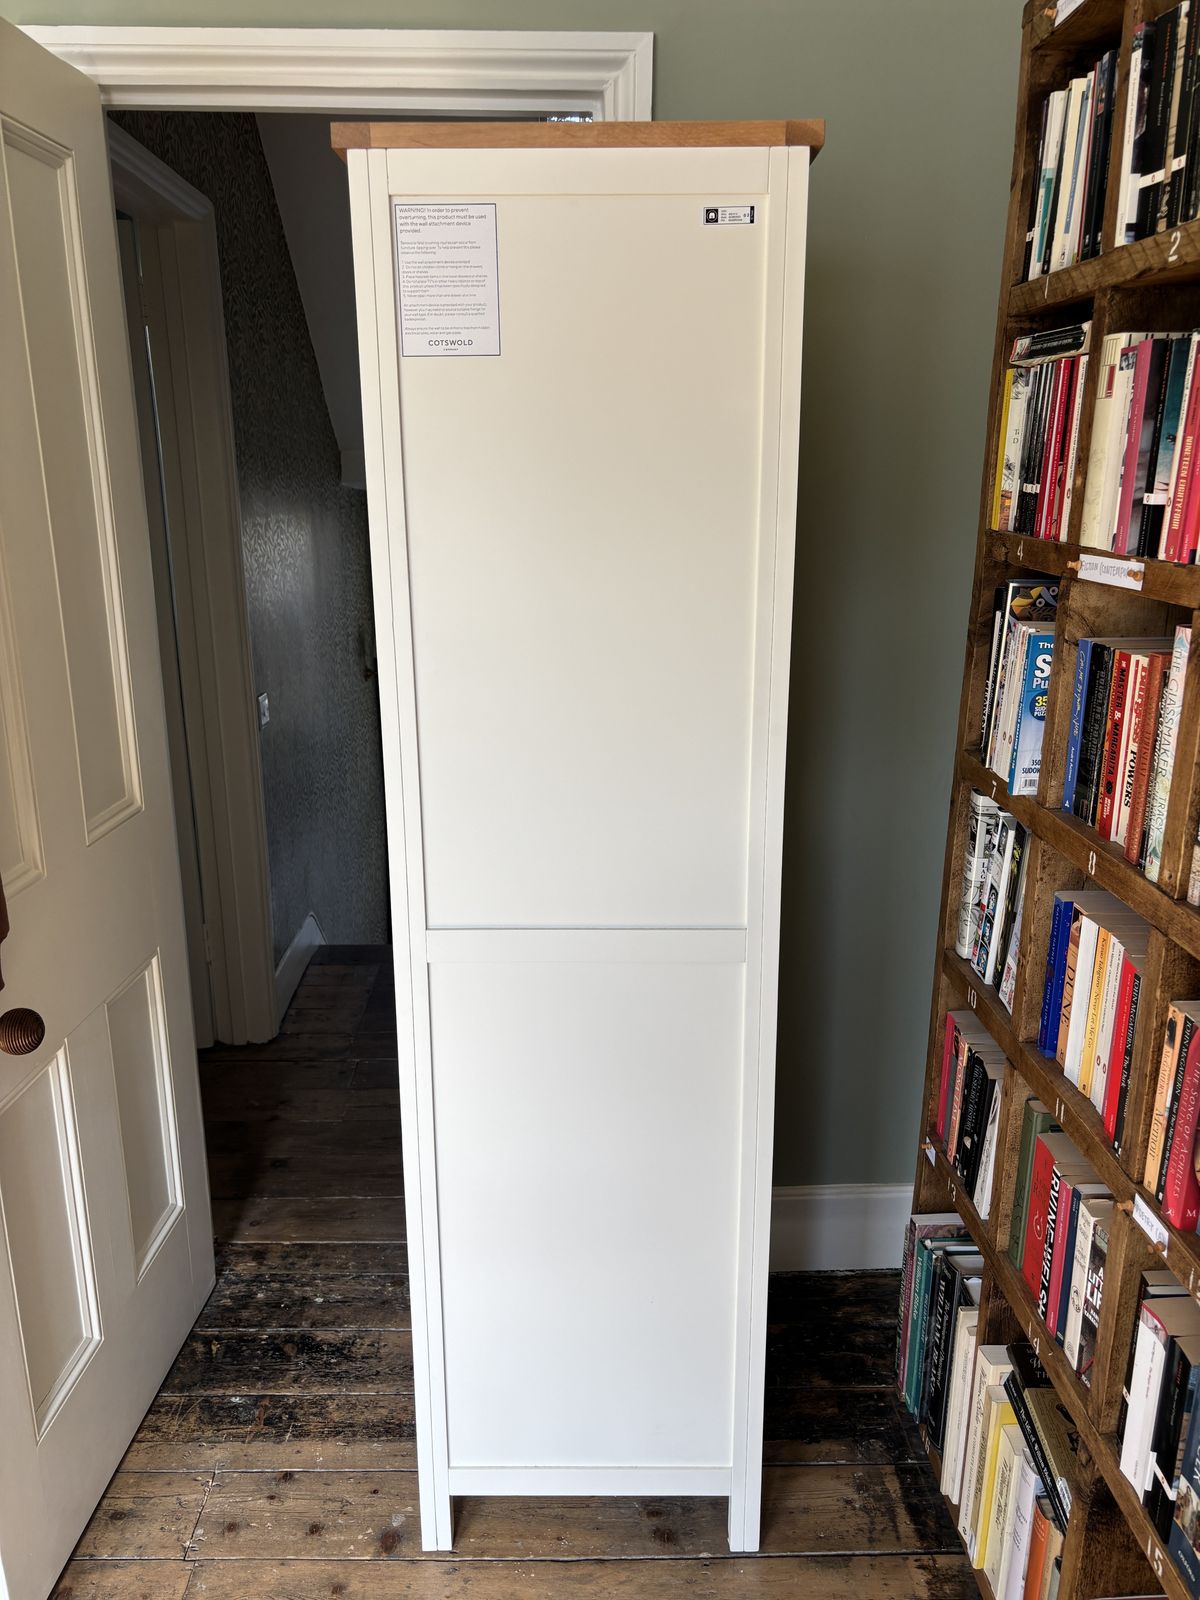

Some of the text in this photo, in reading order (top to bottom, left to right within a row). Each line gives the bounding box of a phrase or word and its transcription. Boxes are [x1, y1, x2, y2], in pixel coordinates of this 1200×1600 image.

[1168, 231, 1181, 261] 2
[1171, 436, 1194, 530] NINETEEN EIGHTY-FOUR
[1017, 540, 1024, 560] 4
[1107, 668, 1127, 776] MASTER & MARGARITA
[1157, 649, 1183, 778] THE GLASSMAKER
[1123, 749, 1137, 808] POWERS
[1156, 796, 1167, 834] TRACY
[1099, 938, 1107, 959] Kazuo
[1095, 960, 1103, 988] Ishiguro
[1132, 979, 1140, 1003] JOHN
[1061, 965, 1076, 1028] DUNE
[1092, 990, 1100, 1012] Never
[1087, 1037, 1094, 1048] Go
[1125, 1004, 1137, 1050] McGAHERN
[1184, 1021, 1192, 1045] JOHN
[955, 1054, 963, 1091] MONA
[1158, 1048, 1170, 1096] McGAHERN
[1175, 1046, 1188, 1096] McGAHERN
[1186, 1088, 1199, 1122] SONG
[1149, 1108, 1165, 1162] Memoir
[1170, 1076, 1192, 1176] MADELINE MILLER
[1183, 1125, 1191, 1140] OF
[1173, 1146, 1189, 1199] ACHILLES
[1186, 1209, 1197, 1217] M
[1037, 1166, 1061, 1320] IRVINE WELSH
[912, 1256, 922, 1320] William Blake
[1086, 1280, 1102, 1310] LIF
[1088, 1269, 1104, 1293] LITT
[930, 1280, 946, 1397] WILLIAM BLAKE
[1024, 1420, 1032, 1433] Life
